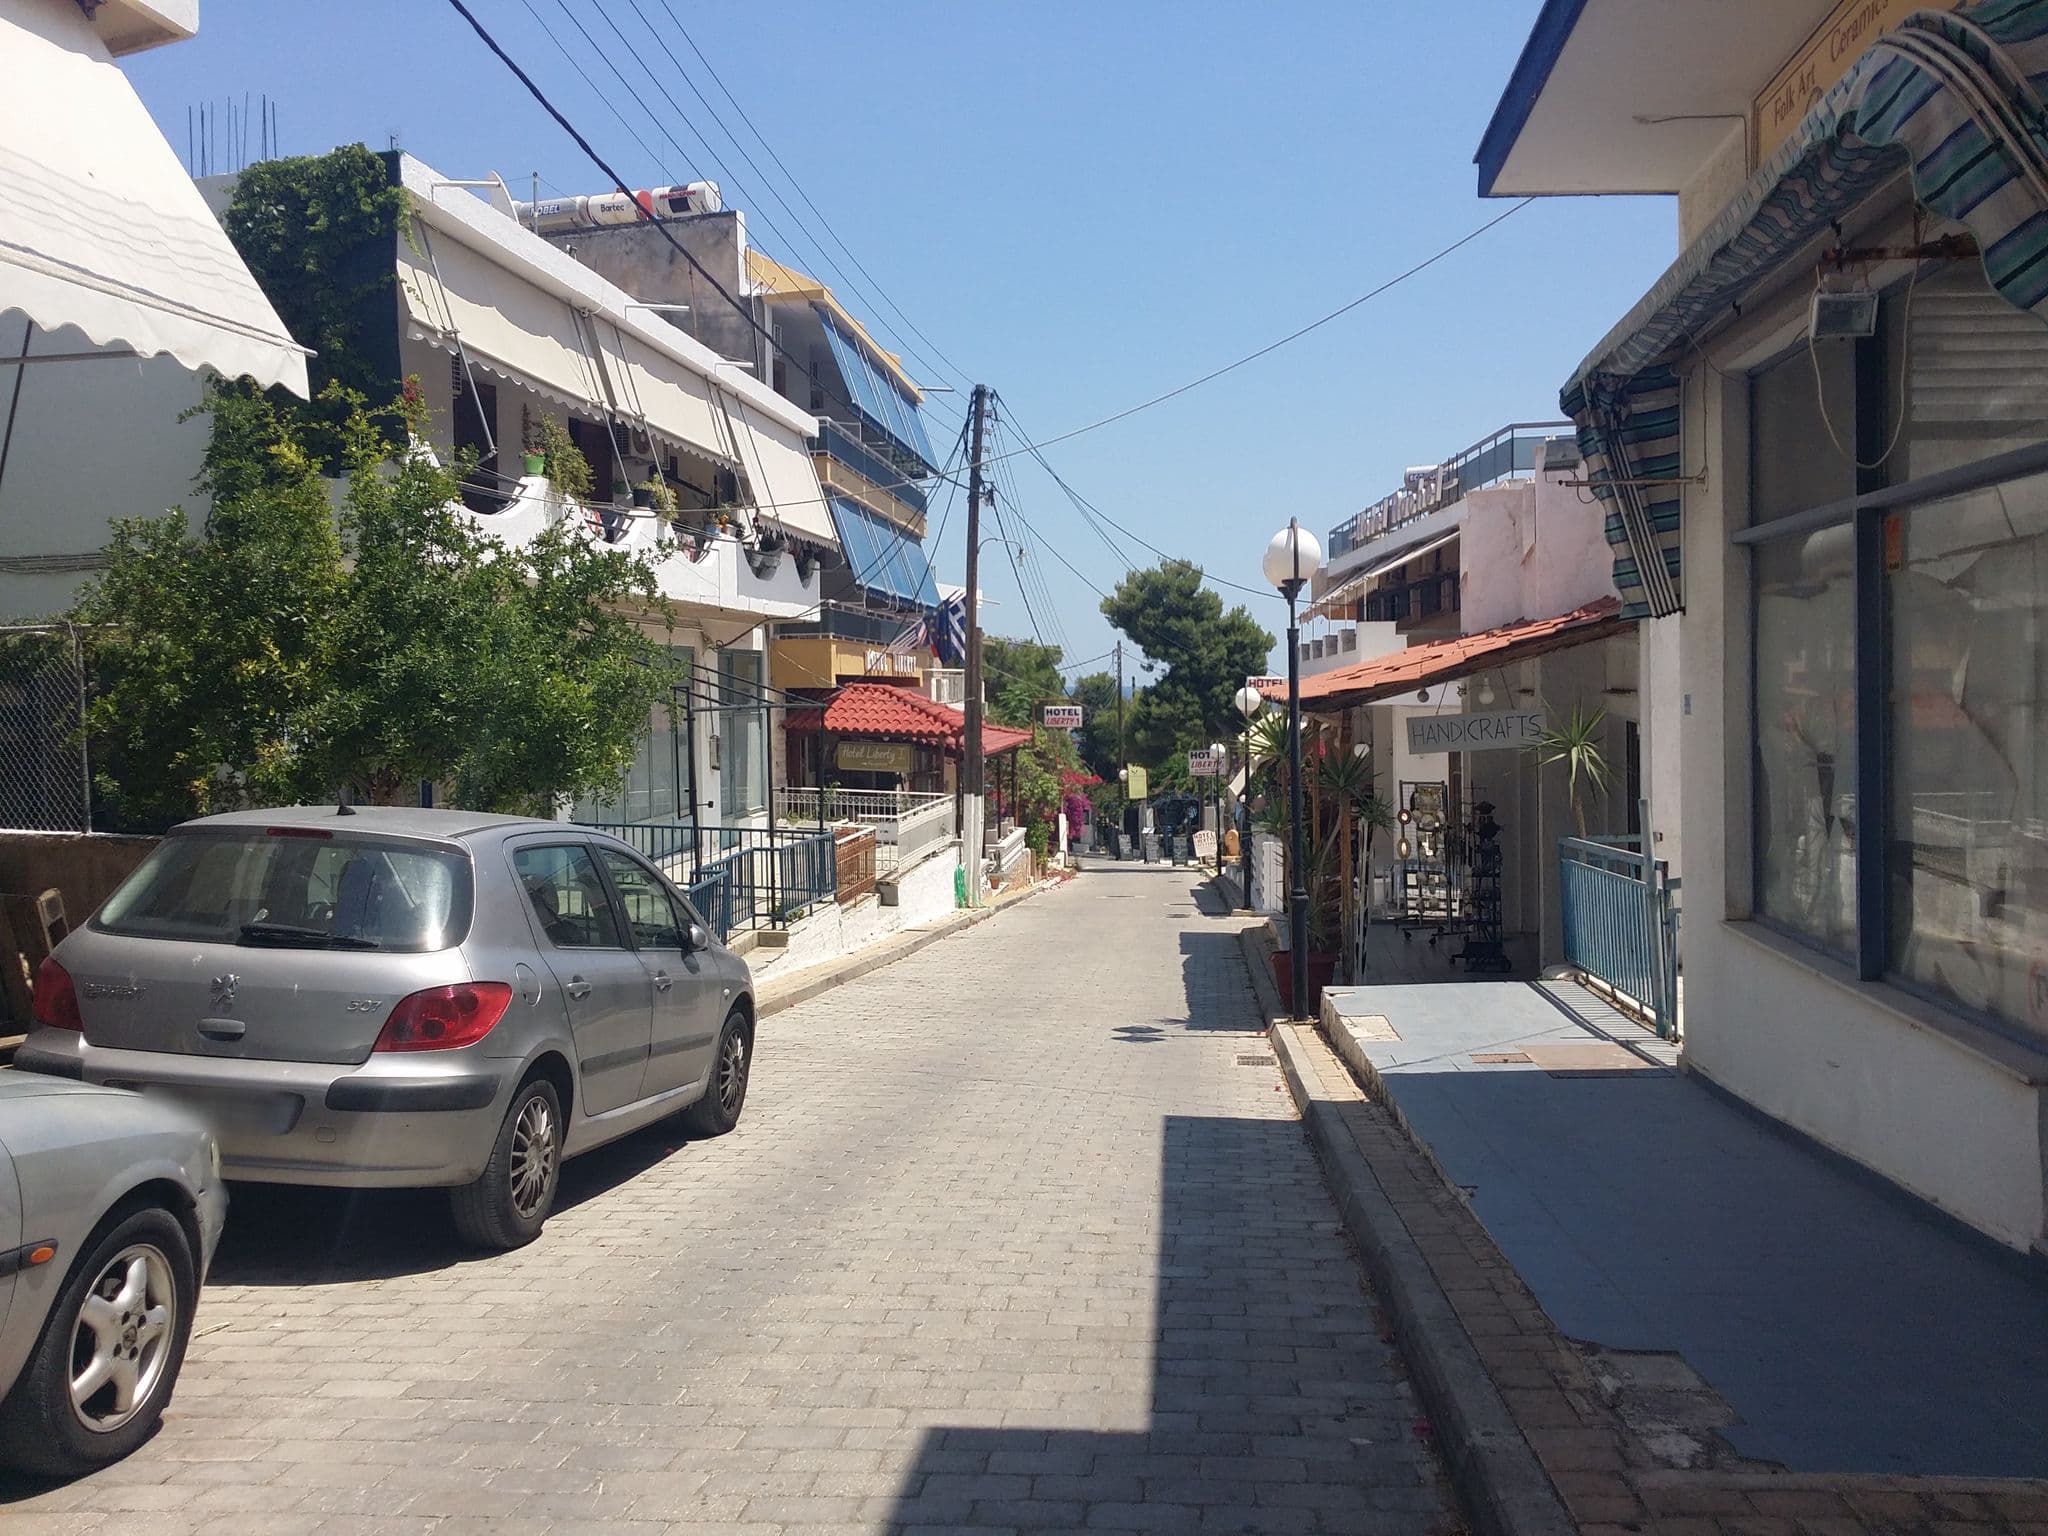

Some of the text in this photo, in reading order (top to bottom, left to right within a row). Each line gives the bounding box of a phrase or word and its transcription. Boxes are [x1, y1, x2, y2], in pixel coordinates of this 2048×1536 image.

[1774, 86, 1795, 128] Folk
[1799, 63, 1816, 96] Art
[600, 203, 625, 213] Bartec
[1046, 708, 1080, 716] HOTEL
[1412, 713, 1543, 746] HANDICRAFTS
[841, 744, 865, 760] Hotel
[866, 743, 896, 765] Liberty
